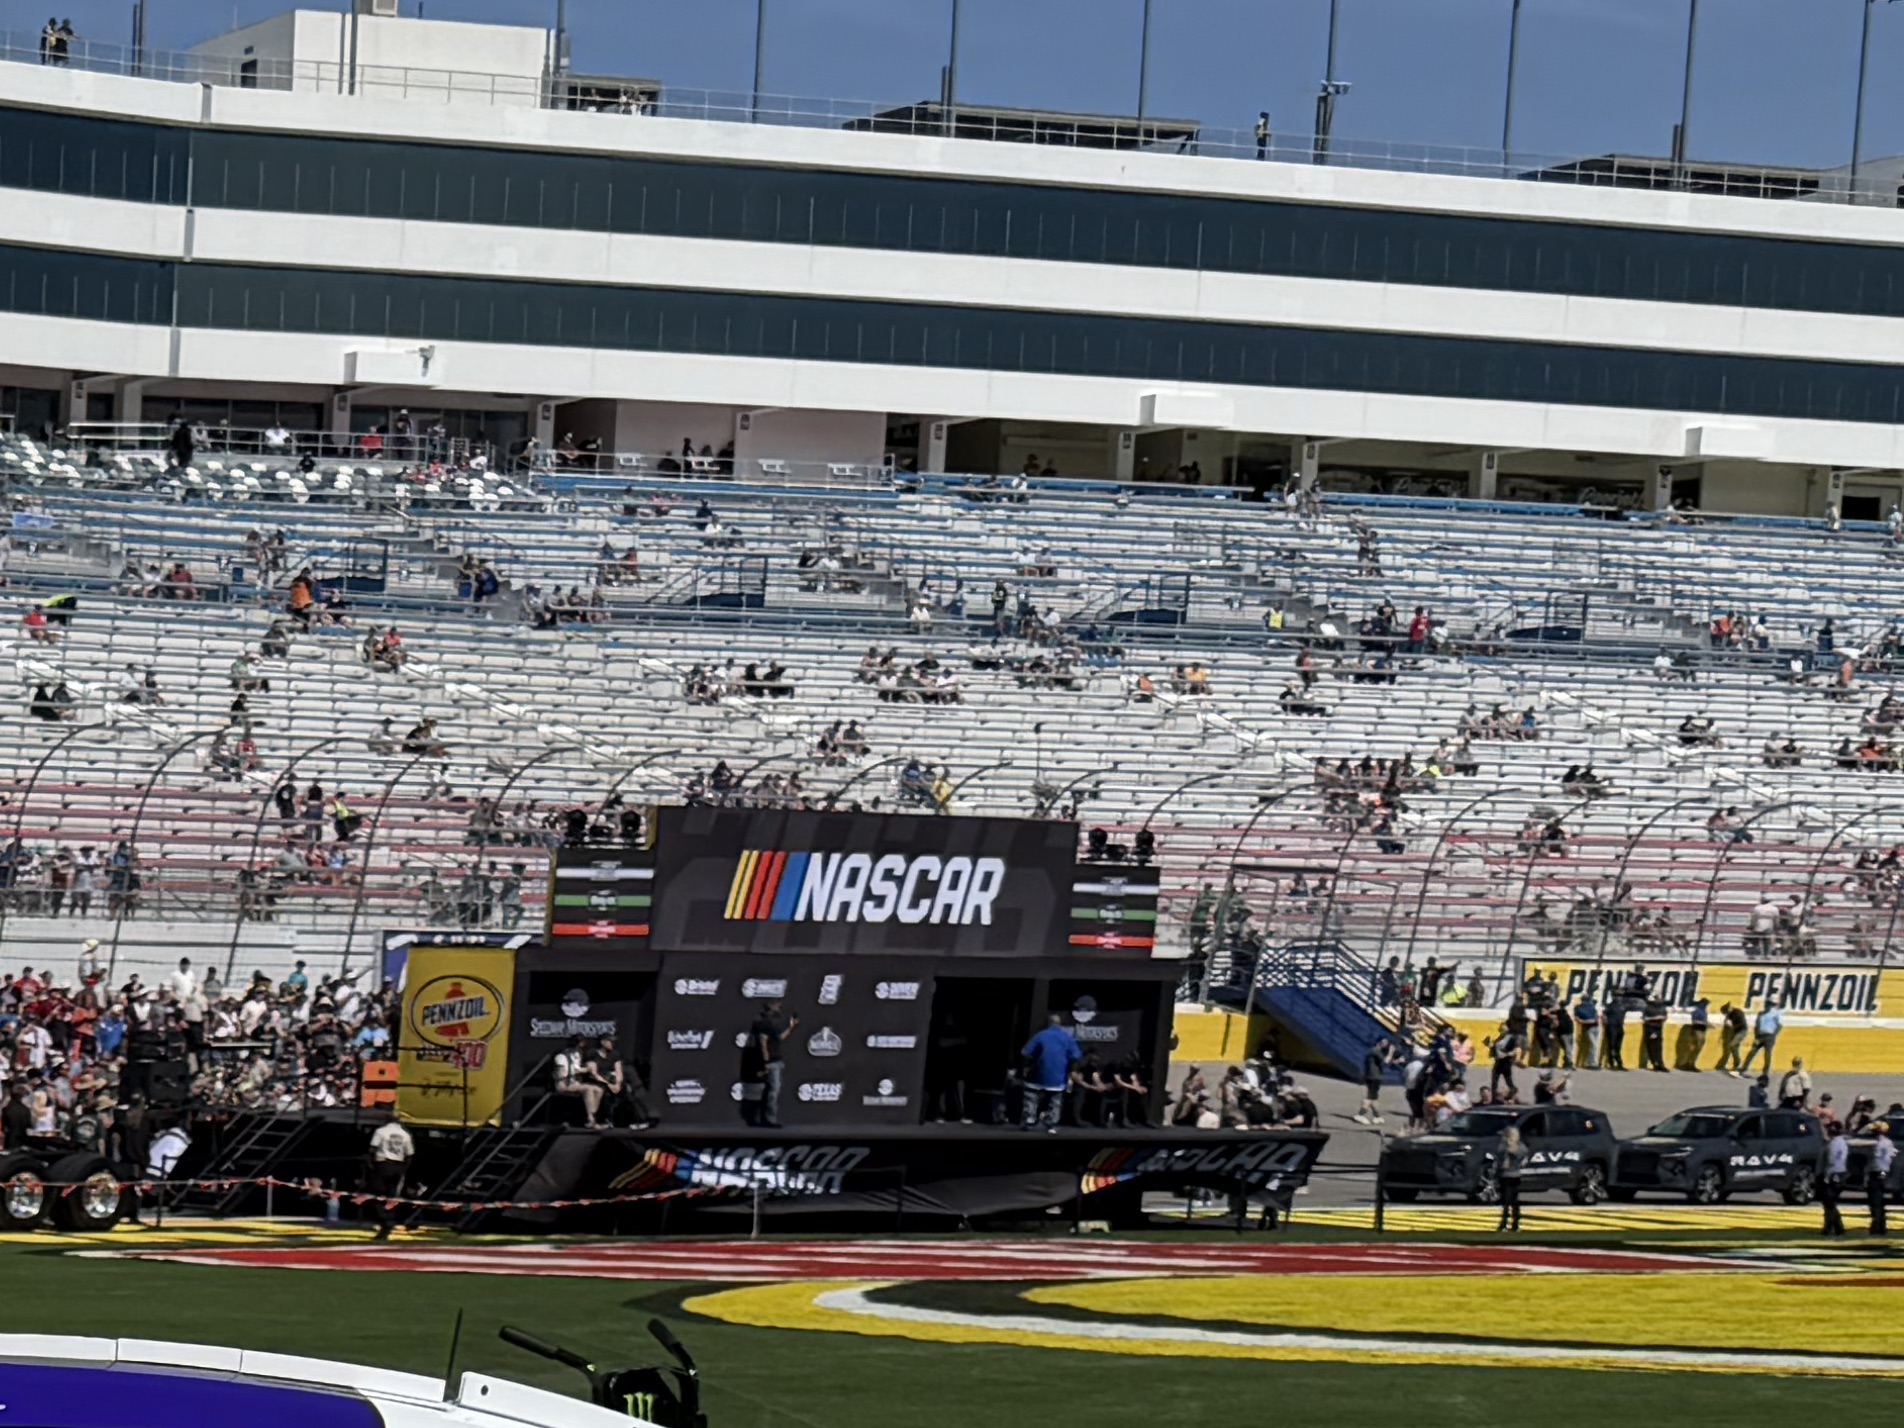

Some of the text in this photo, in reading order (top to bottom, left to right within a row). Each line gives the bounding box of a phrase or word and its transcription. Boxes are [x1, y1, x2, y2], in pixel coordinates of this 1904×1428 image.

[795, 854, 1005, 925] NASCAR
[1566, 968, 1699, 1008] PENZOIL
[1744, 972, 1878, 1012] PENNZOIL
[422, 996, 490, 1027] PENNZOIL
